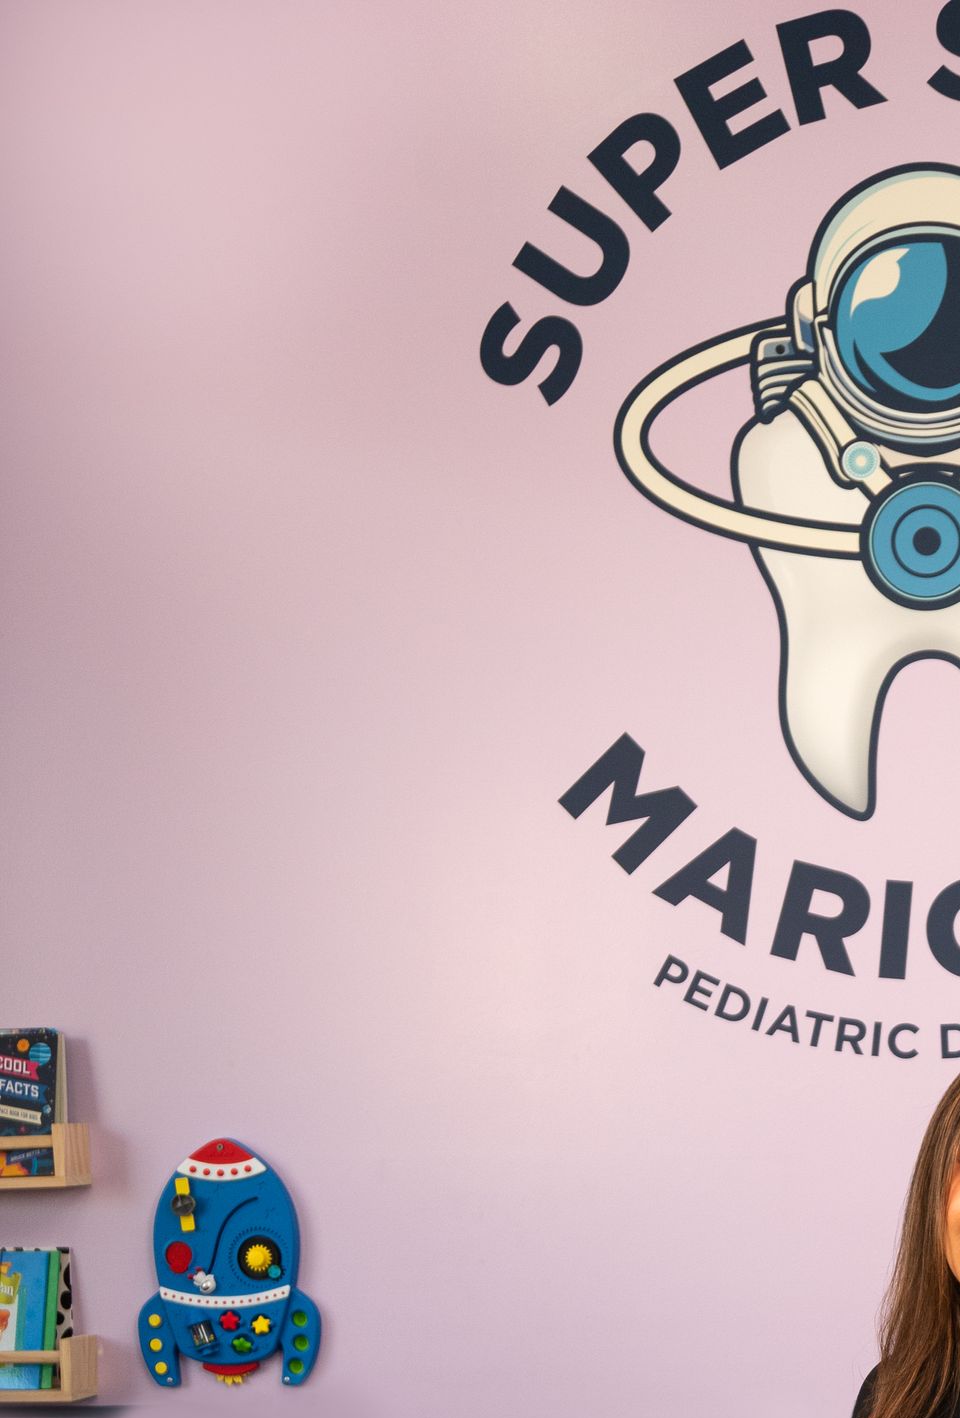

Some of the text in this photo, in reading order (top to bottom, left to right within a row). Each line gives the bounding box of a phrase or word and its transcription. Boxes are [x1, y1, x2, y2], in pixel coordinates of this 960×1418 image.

[480, 9, 888, 406] SUPER
[654, 955, 919, 1059] PEDIATRIC
[0, 1079, 39, 1098] FACTS
